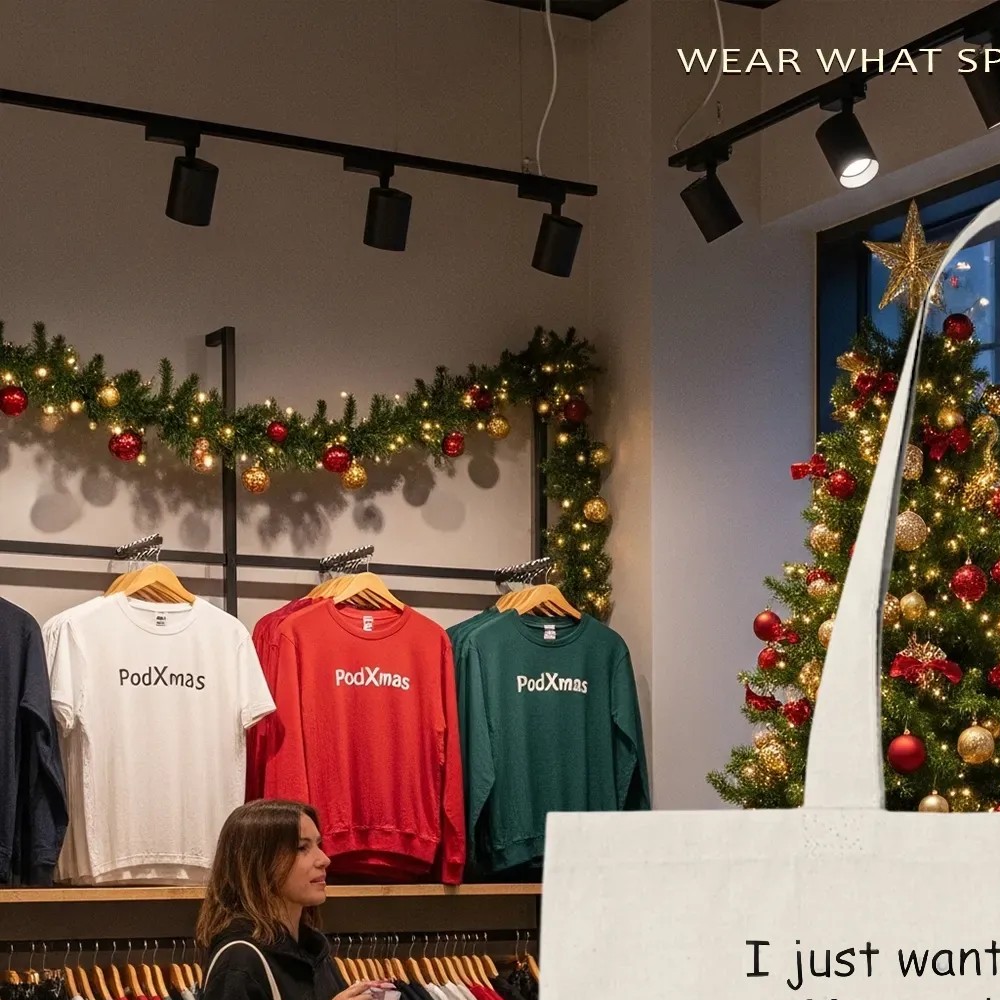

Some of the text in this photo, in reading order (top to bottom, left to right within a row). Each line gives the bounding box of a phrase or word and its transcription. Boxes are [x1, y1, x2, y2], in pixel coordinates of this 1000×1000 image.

[119, 665, 206, 691] PodXmas
[335, 666, 410, 690] PodXmas
[516, 672, 588, 694] PodXmas
[745, 940, 771, 978] I
[786, 939, 880, 991] just
